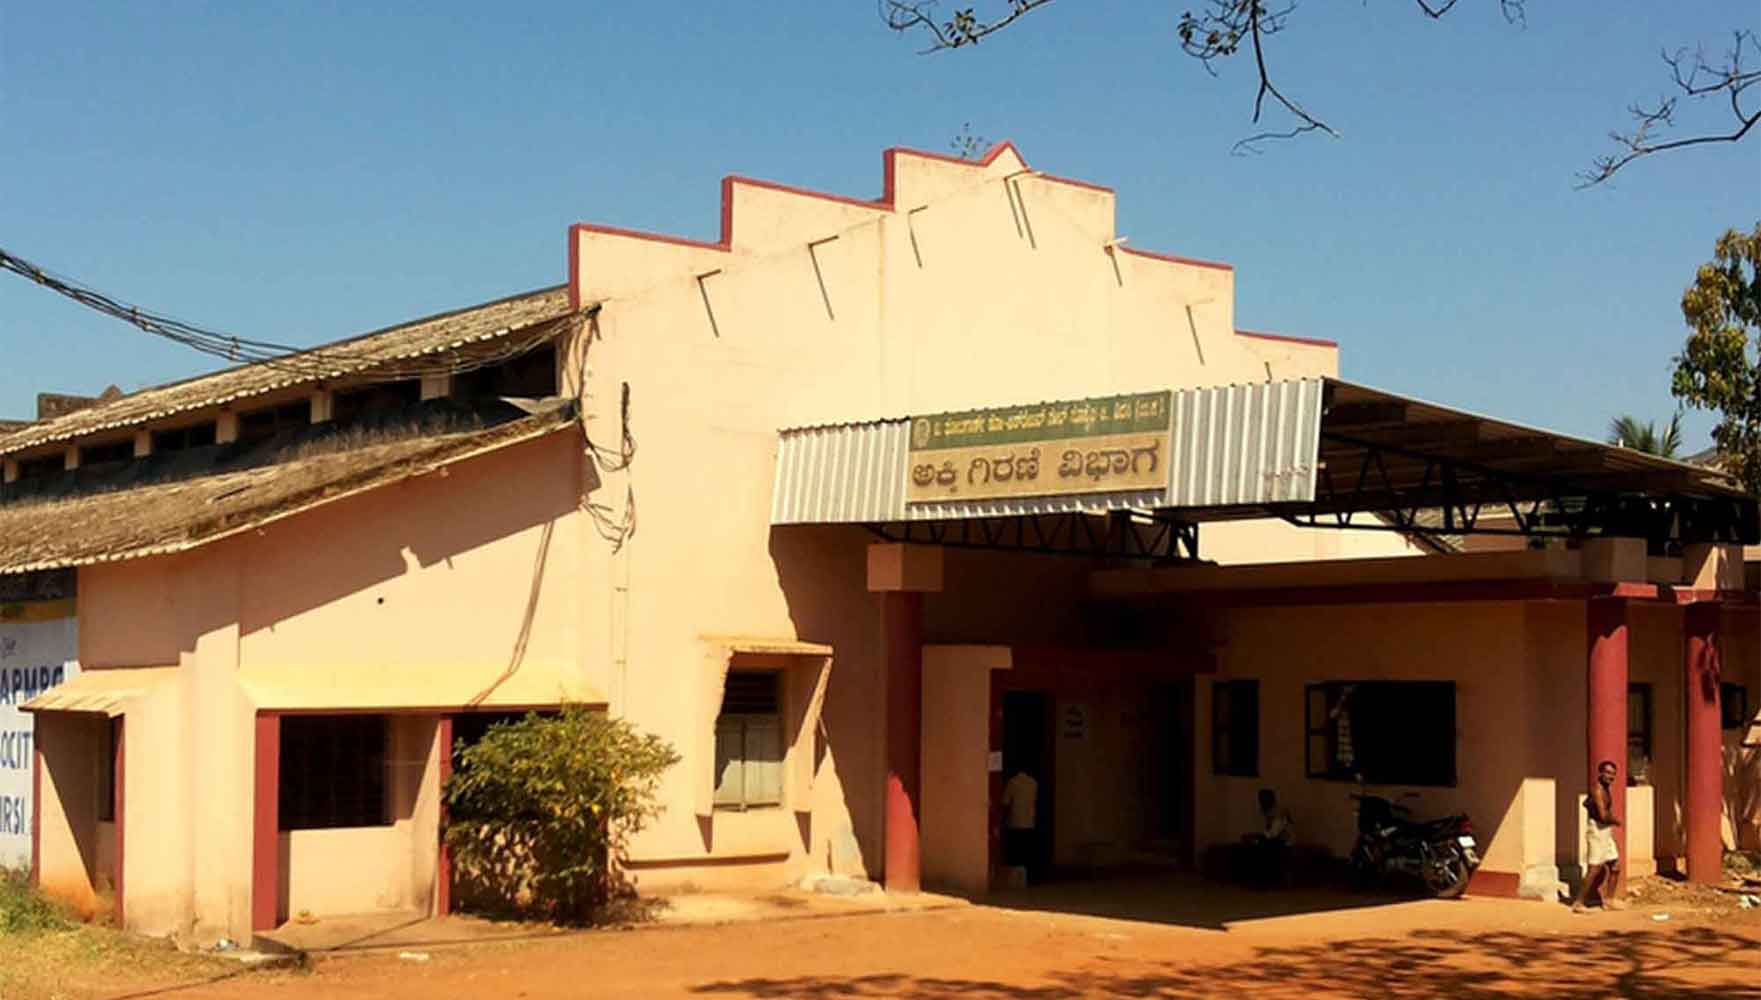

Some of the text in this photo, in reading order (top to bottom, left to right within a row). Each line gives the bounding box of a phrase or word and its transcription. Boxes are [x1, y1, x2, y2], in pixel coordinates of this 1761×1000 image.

[911, 439, 1161, 493] ಅಕ್ಕಿ ಗಿರಣಿ ವಿಭಾಗ
